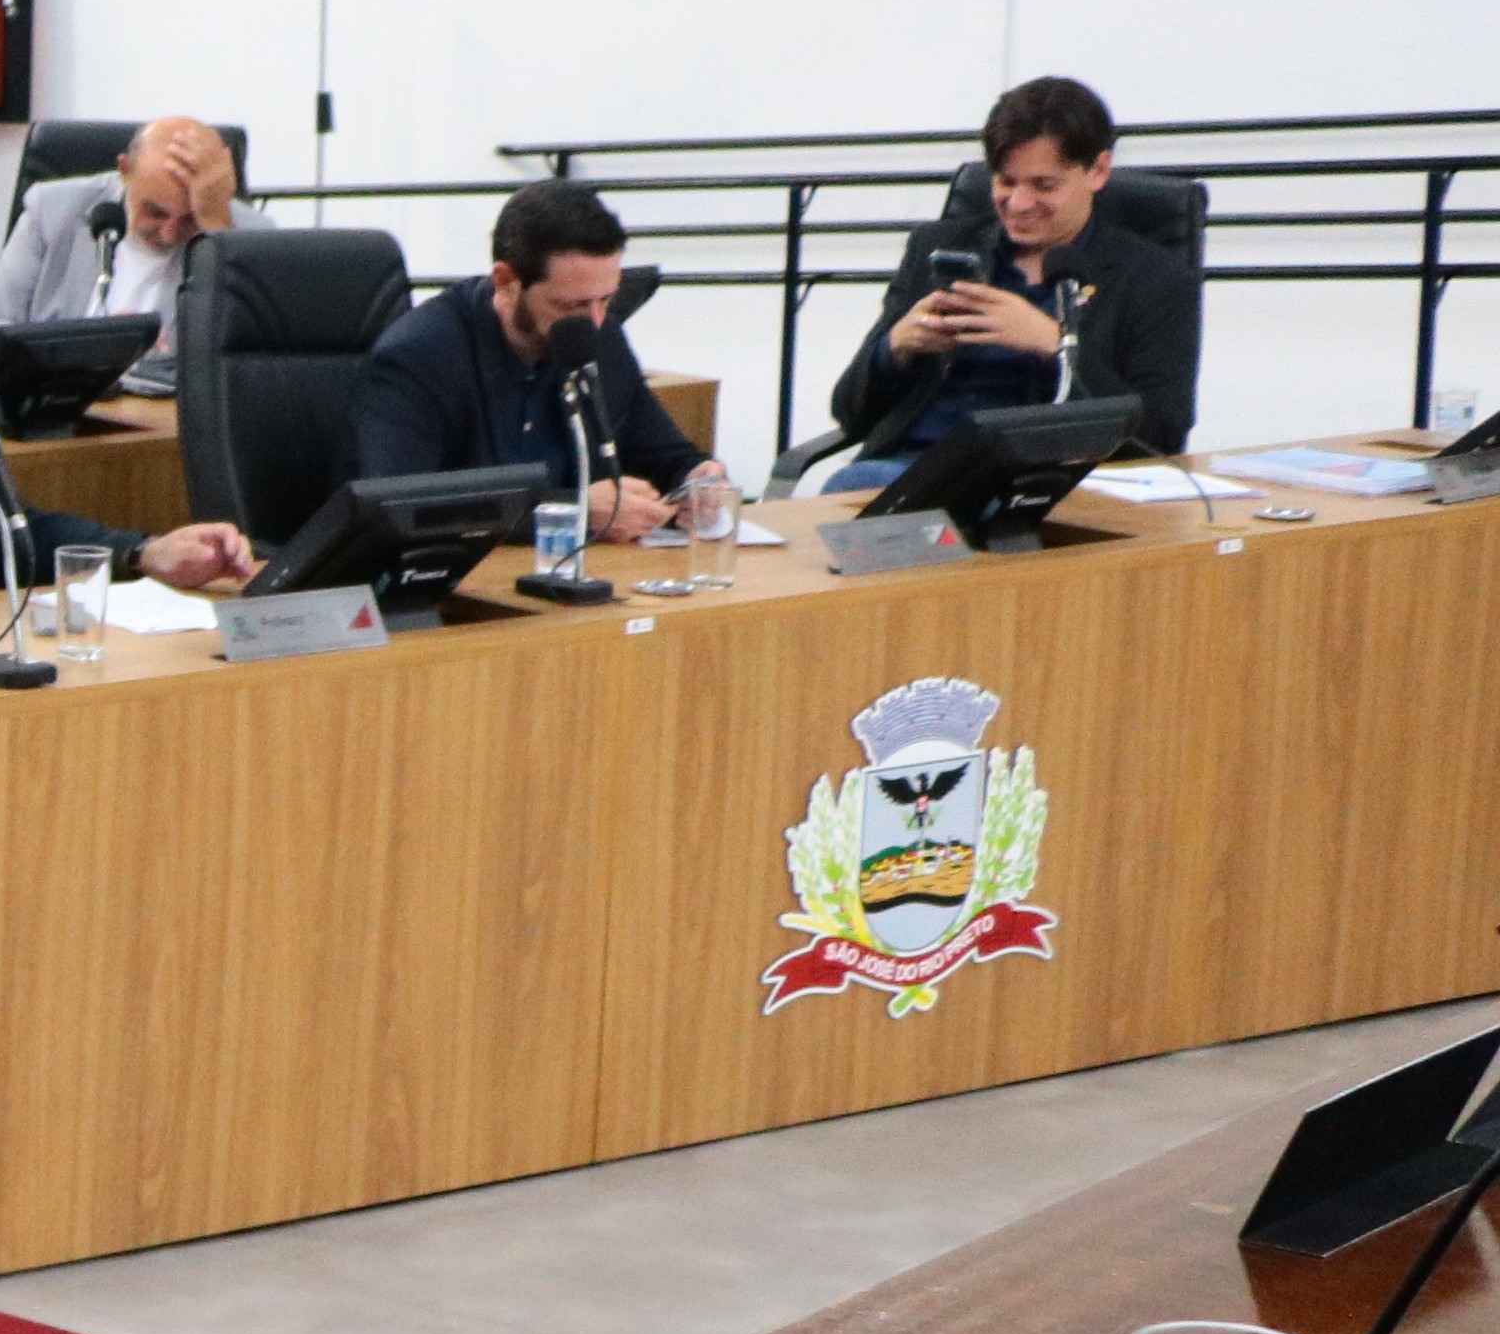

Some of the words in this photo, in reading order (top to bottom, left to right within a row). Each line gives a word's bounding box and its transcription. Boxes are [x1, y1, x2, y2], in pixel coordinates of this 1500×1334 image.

[823, 941, 861, 966] SÃO
[856, 954, 897, 982] JOSÉ
[894, 963, 918, 982] DO
[918, 952, 946, 978] RIO
[943, 914, 996, 962] PRETO
